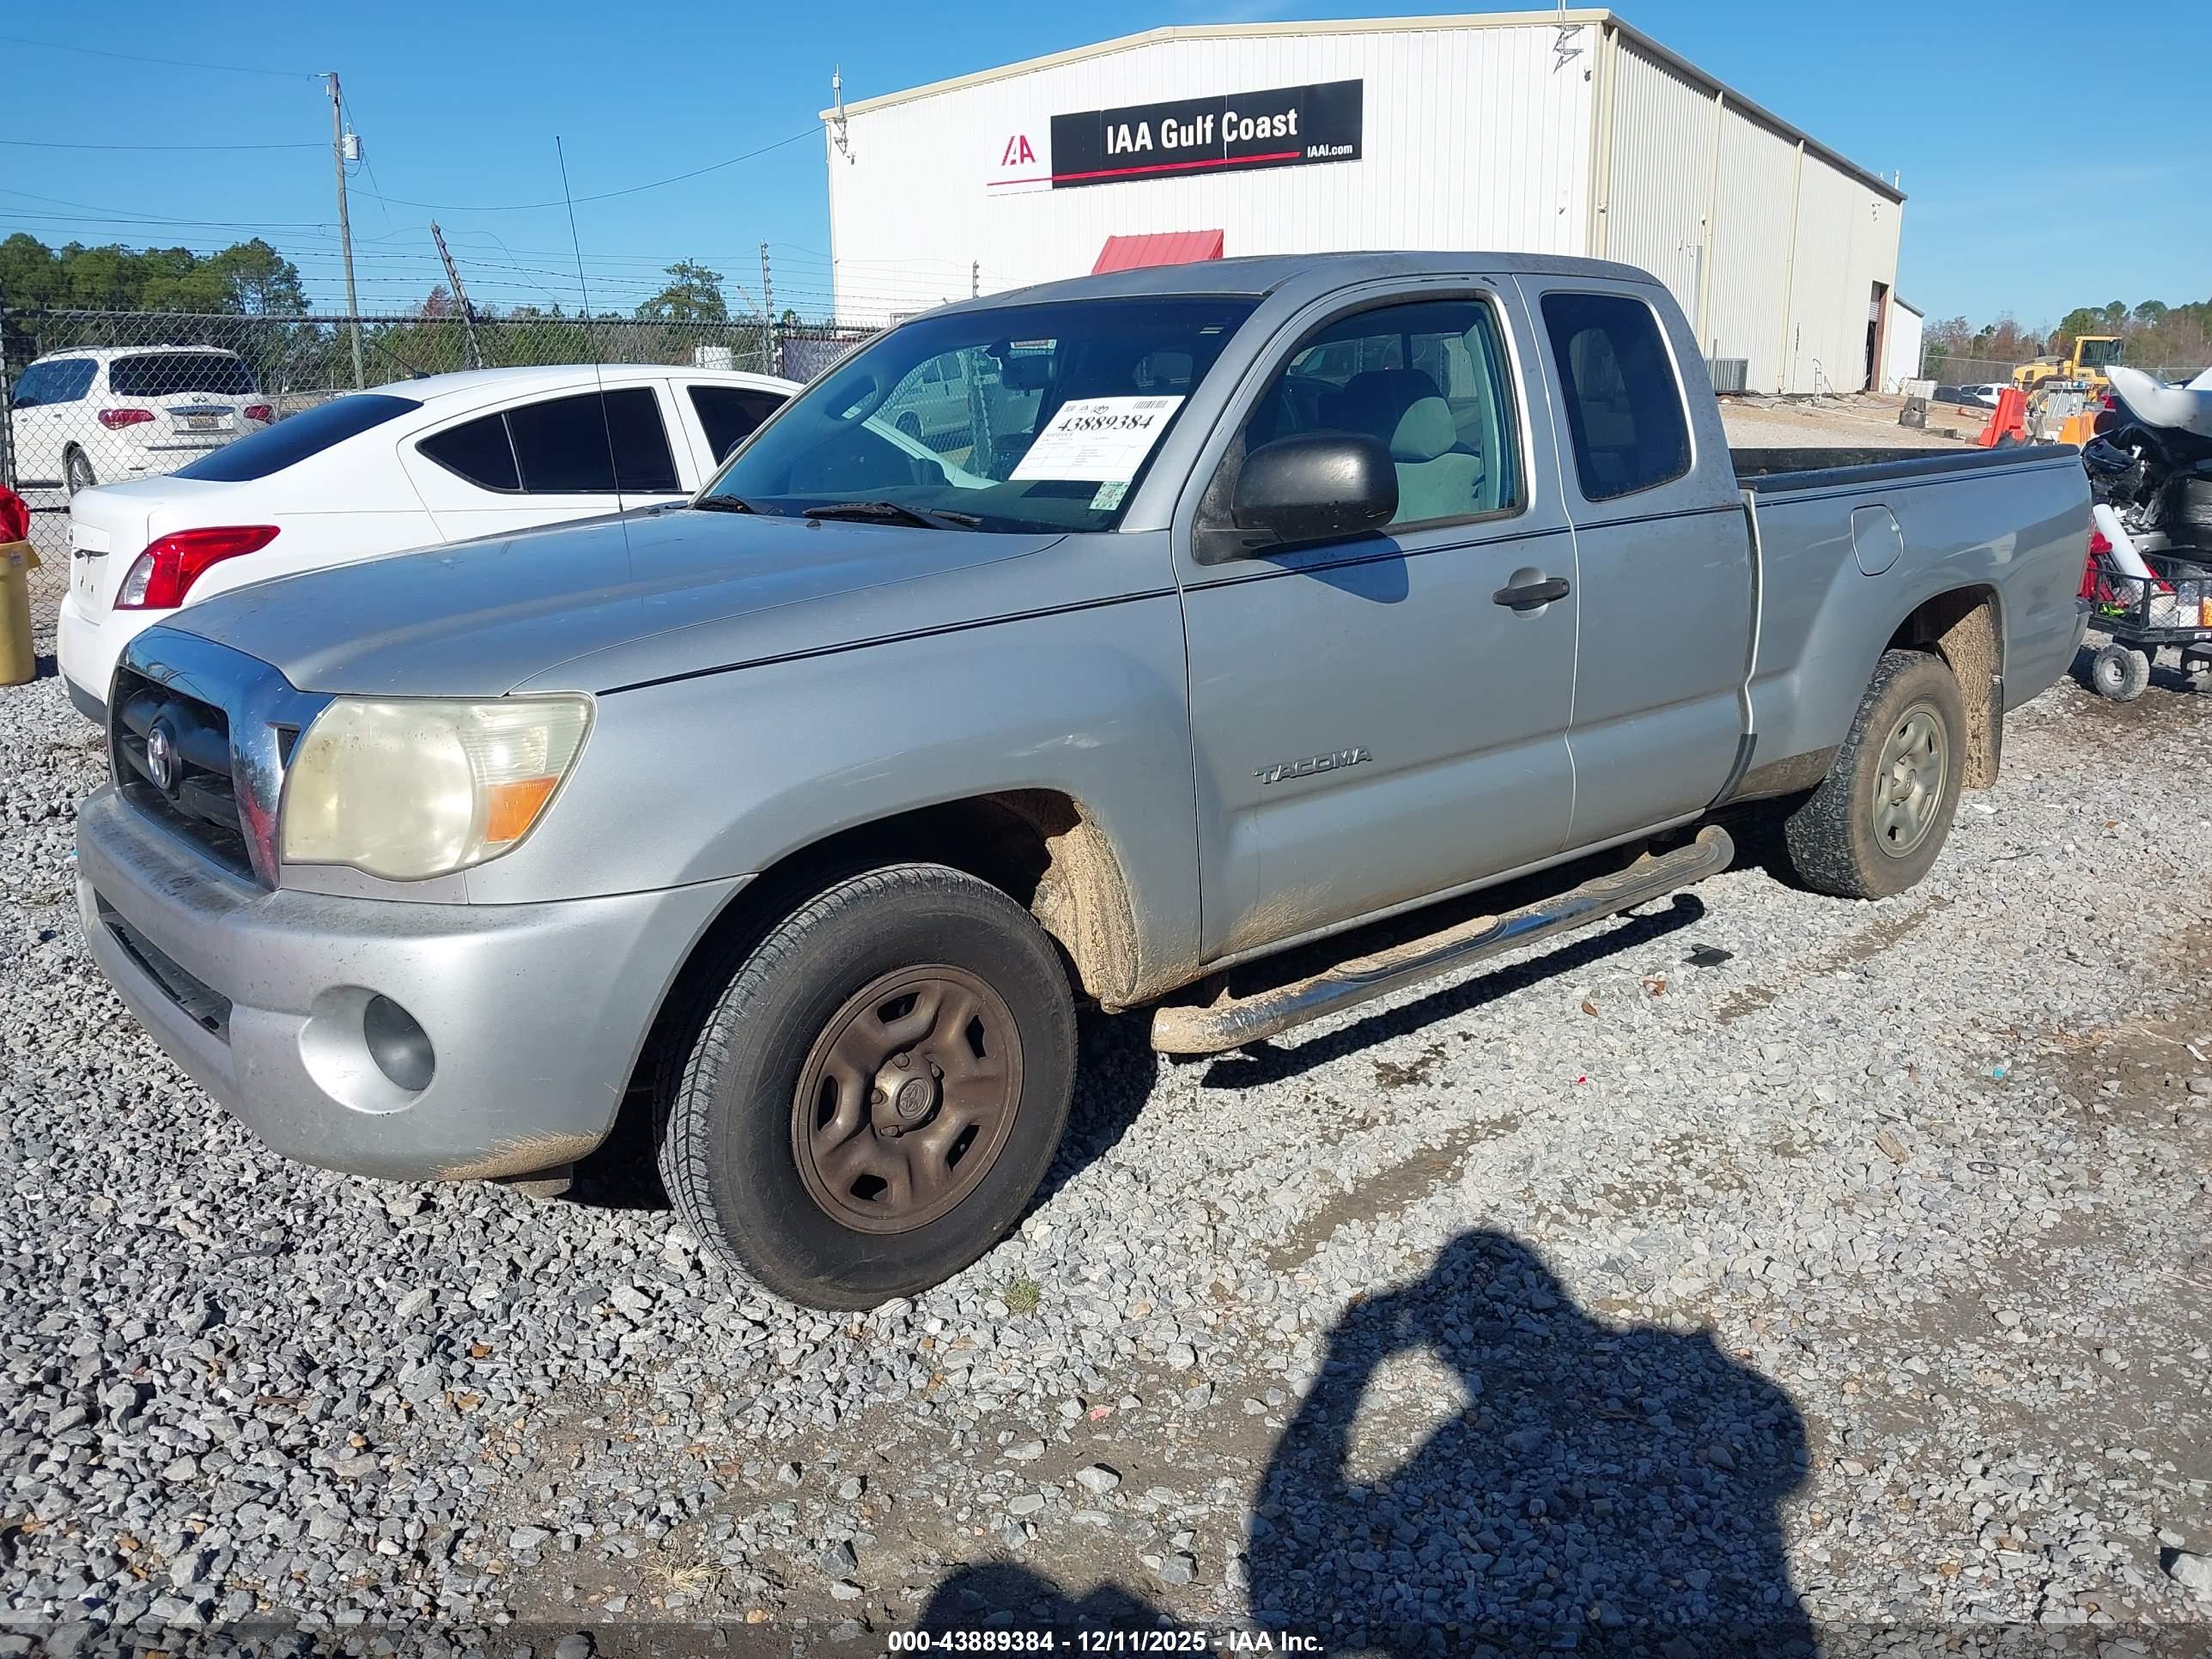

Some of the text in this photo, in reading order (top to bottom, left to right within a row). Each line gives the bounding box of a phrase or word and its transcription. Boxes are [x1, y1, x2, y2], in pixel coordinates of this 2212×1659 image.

[1107, 107, 1297, 155] IAA Gulf Coast
[1058, 414, 1155, 432] 43889384
[1254, 745, 1373, 784] TACOMA
